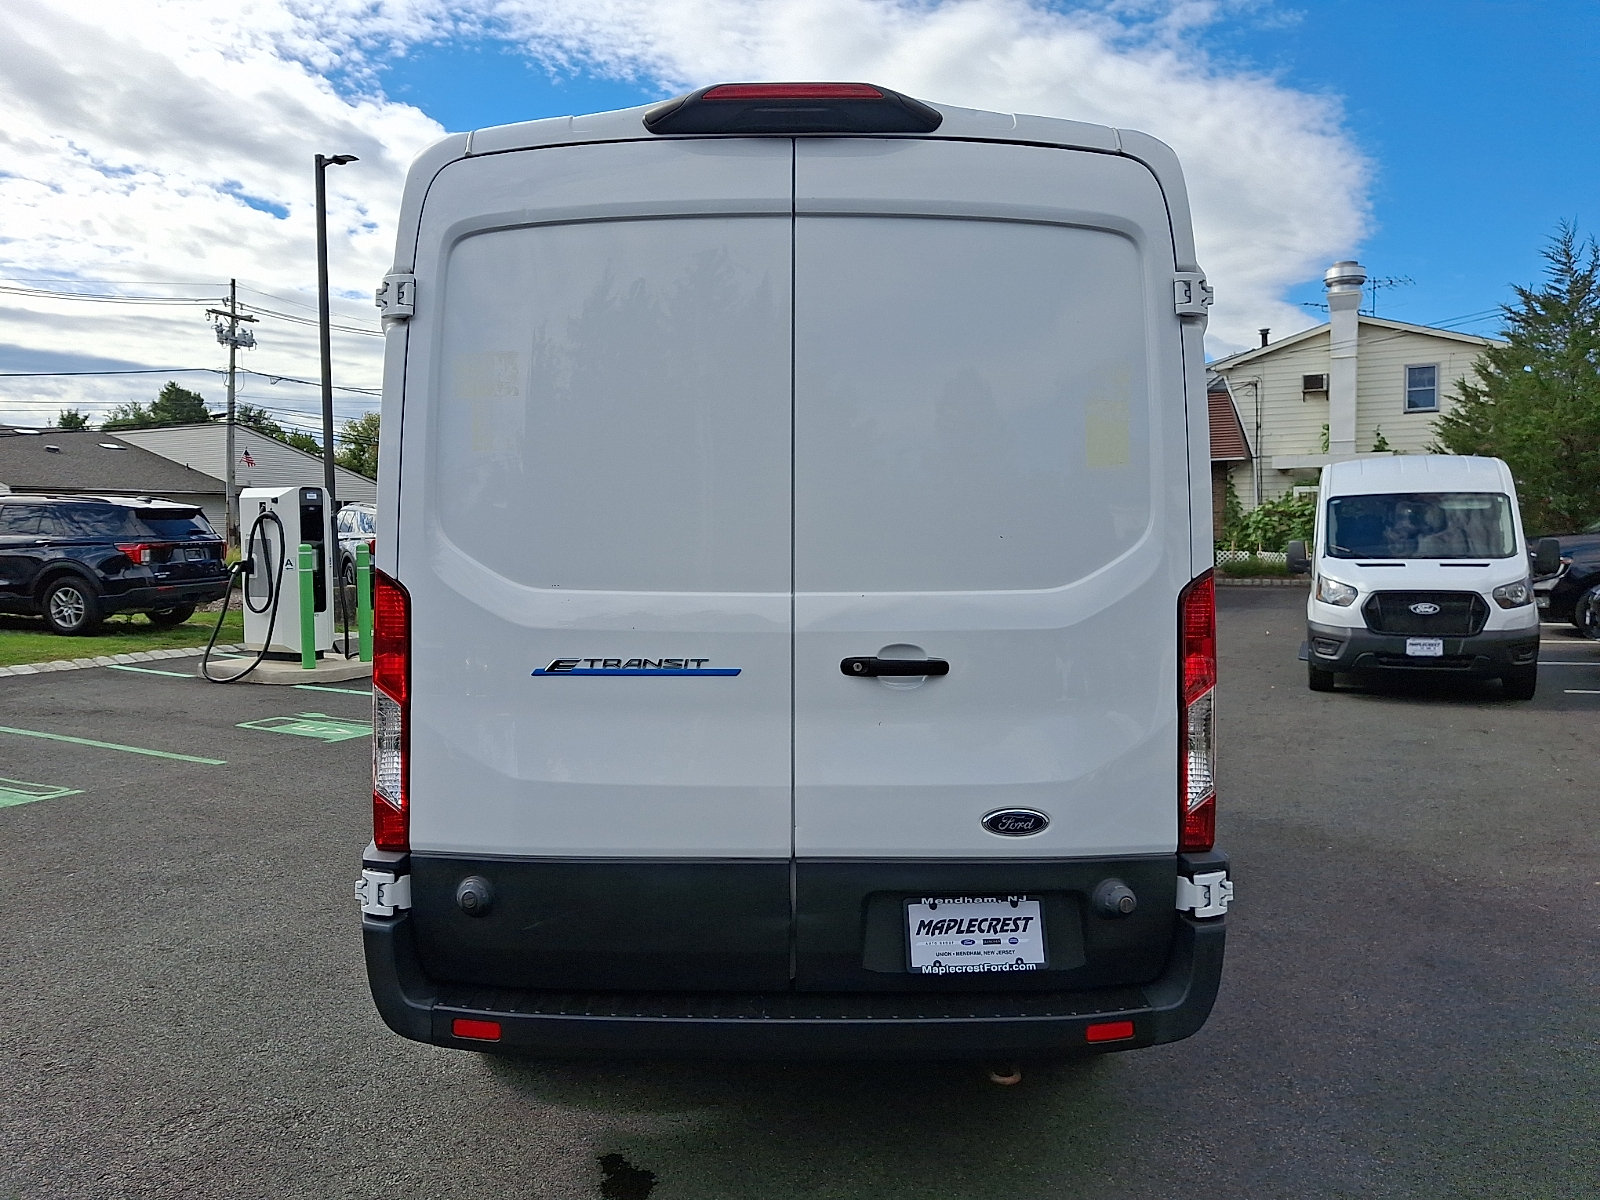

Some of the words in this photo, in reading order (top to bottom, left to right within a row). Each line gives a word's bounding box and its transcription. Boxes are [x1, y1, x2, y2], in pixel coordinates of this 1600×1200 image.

[285, 558, 293, 567] A
[998, 815, 1035, 830] Ford
[915, 916, 1034, 937] MAPLECREST
[921, 962, 1037, 975] MaplecrestFord.com
